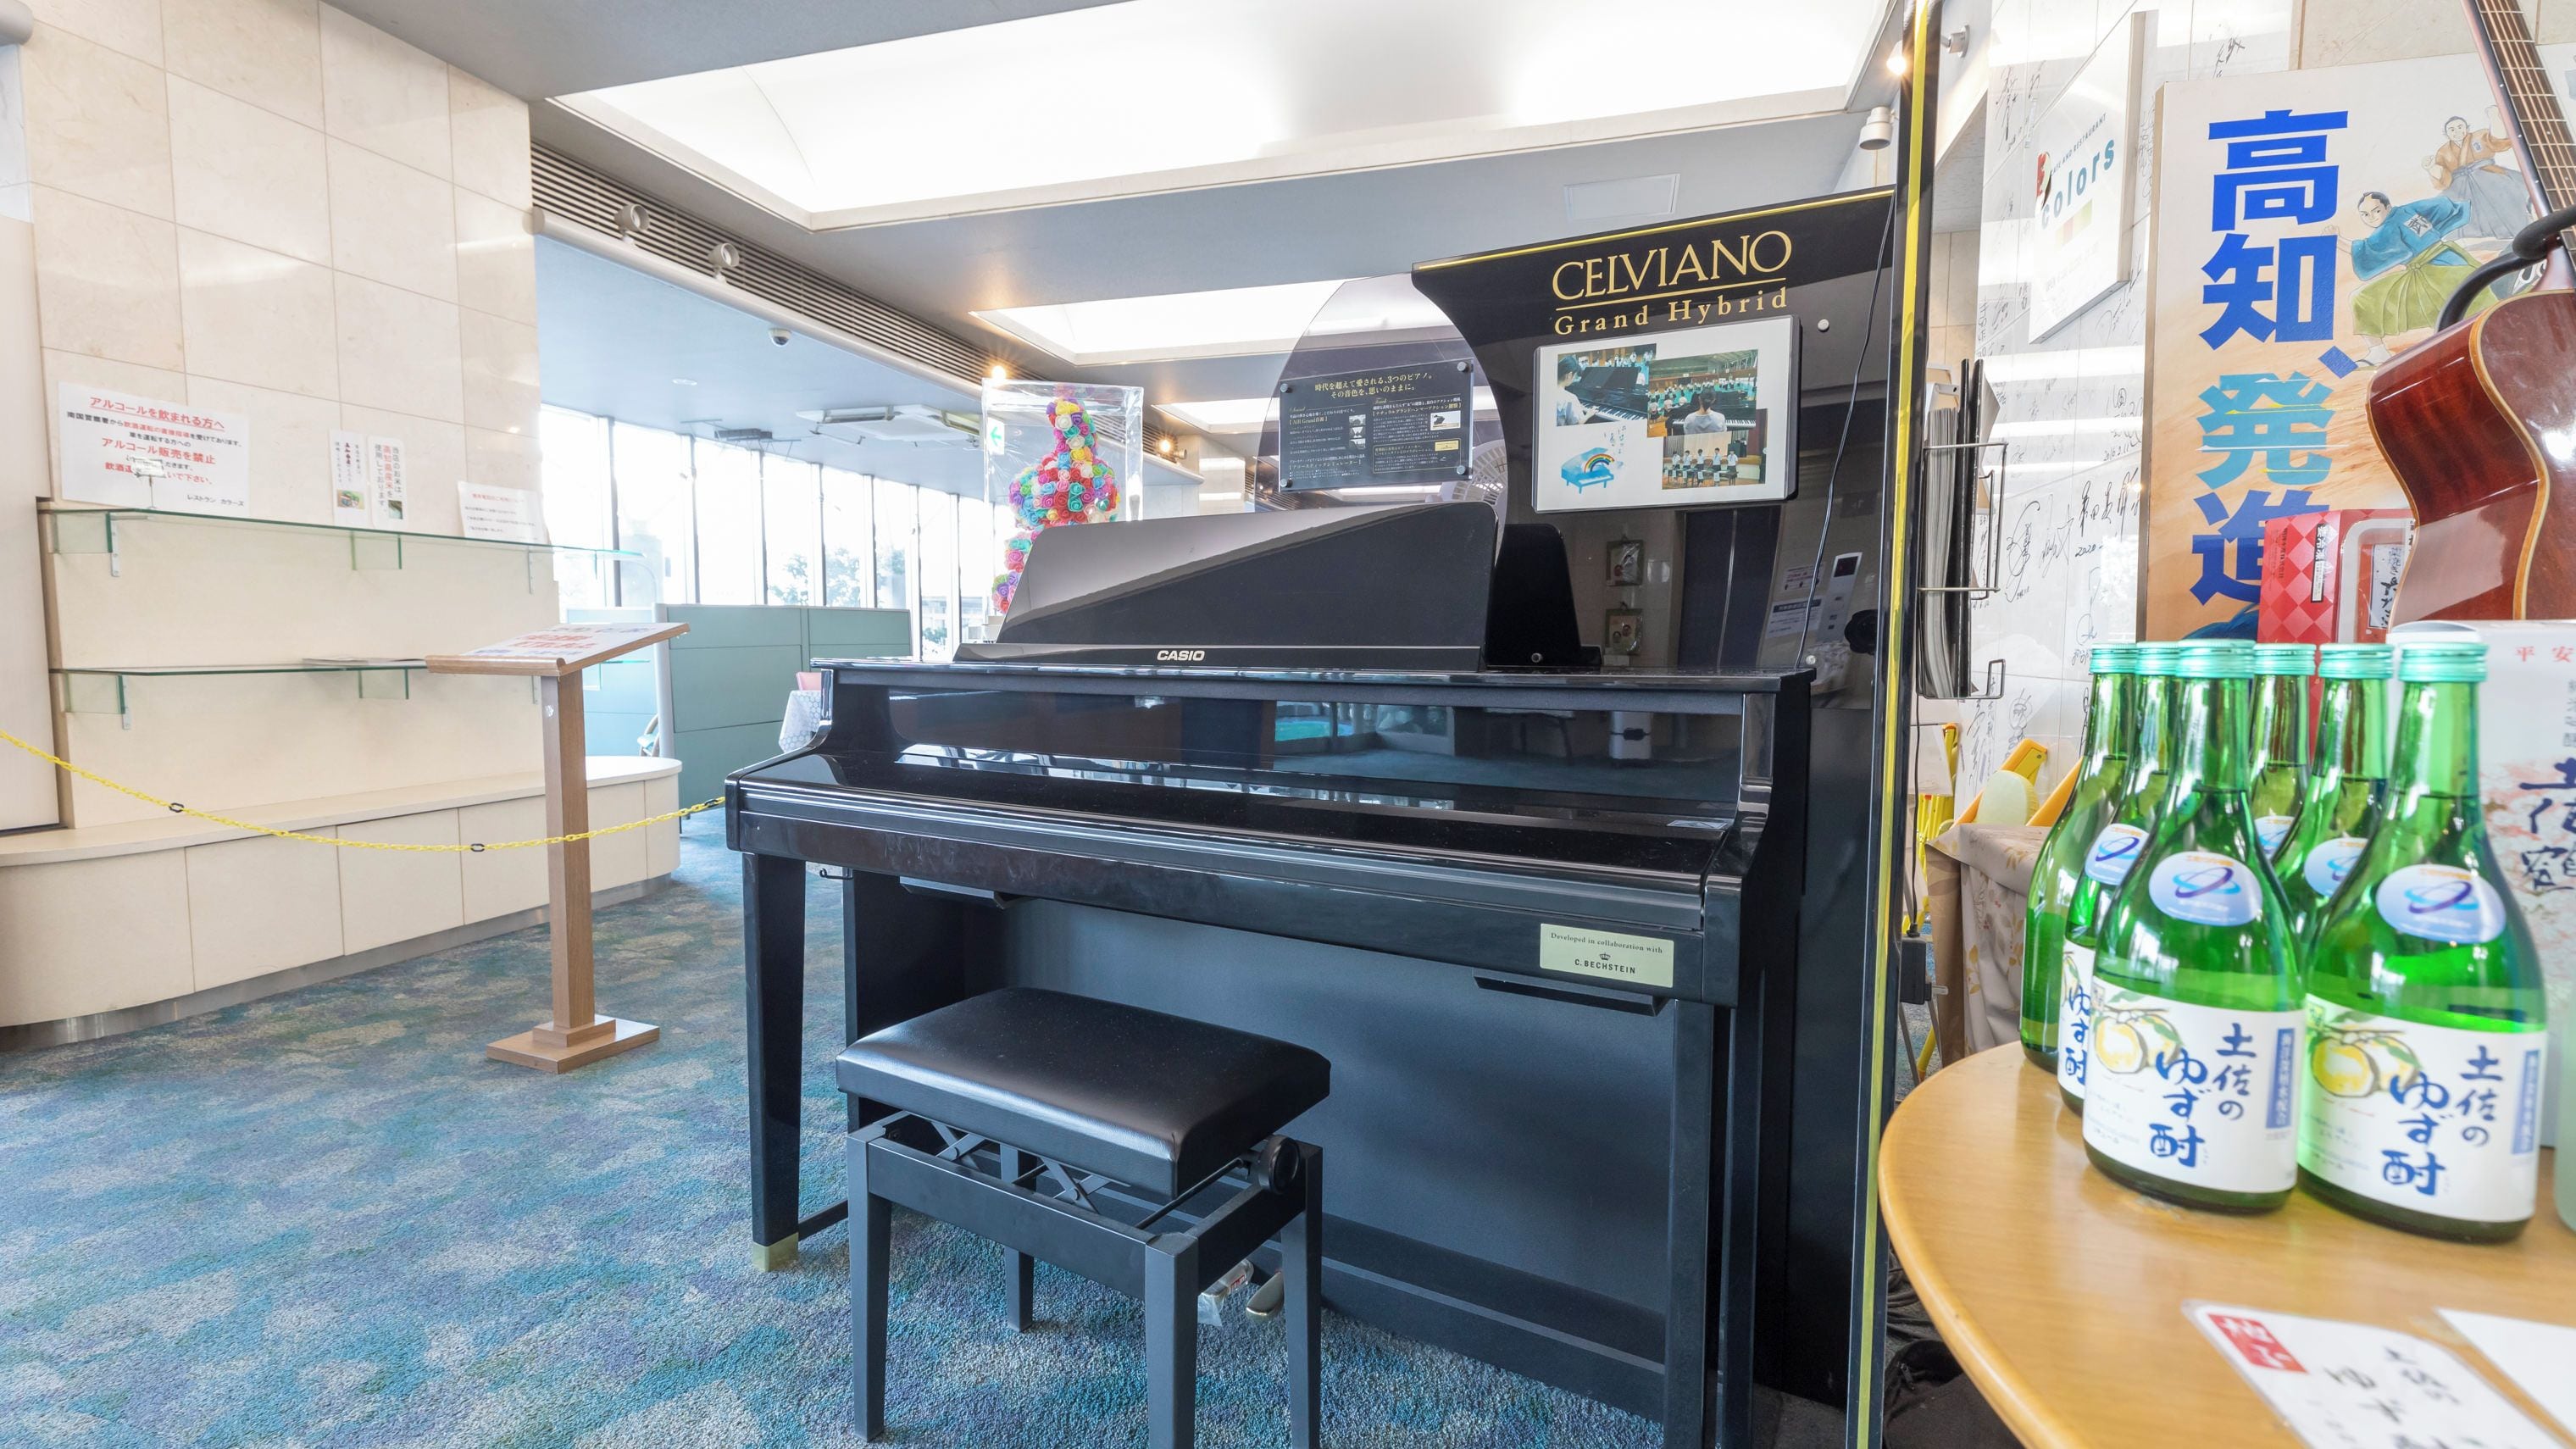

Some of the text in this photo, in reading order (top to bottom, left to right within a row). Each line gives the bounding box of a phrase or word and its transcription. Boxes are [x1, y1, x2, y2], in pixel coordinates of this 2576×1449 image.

[2040, 139, 2115, 230] colors
[1552, 230, 1792, 300] CELVIANO
[1554, 286, 1787, 336] Grand Hybrid
[90, 397, 225, 429] アルコールを飲まれる方へ
[102, 437, 216, 464] アルコール販売を禁止
[129, 431, 192, 447] 車を運転する方への
[1157, 650, 1206, 661] CASIO
[1551, 932, 1586, 943] Developed
[1596, 940, 1644, 952] collaboration
[1584, 960, 1636, 974] BECHSTEIN
[2212, 1023, 2257, 1120] 土佐の
[2457, 1044, 2503, 1146] 土佐の
[2149, 1046, 2212, 1168] ゆず酎
[2382, 1070, 2454, 1196] ゆず酎
